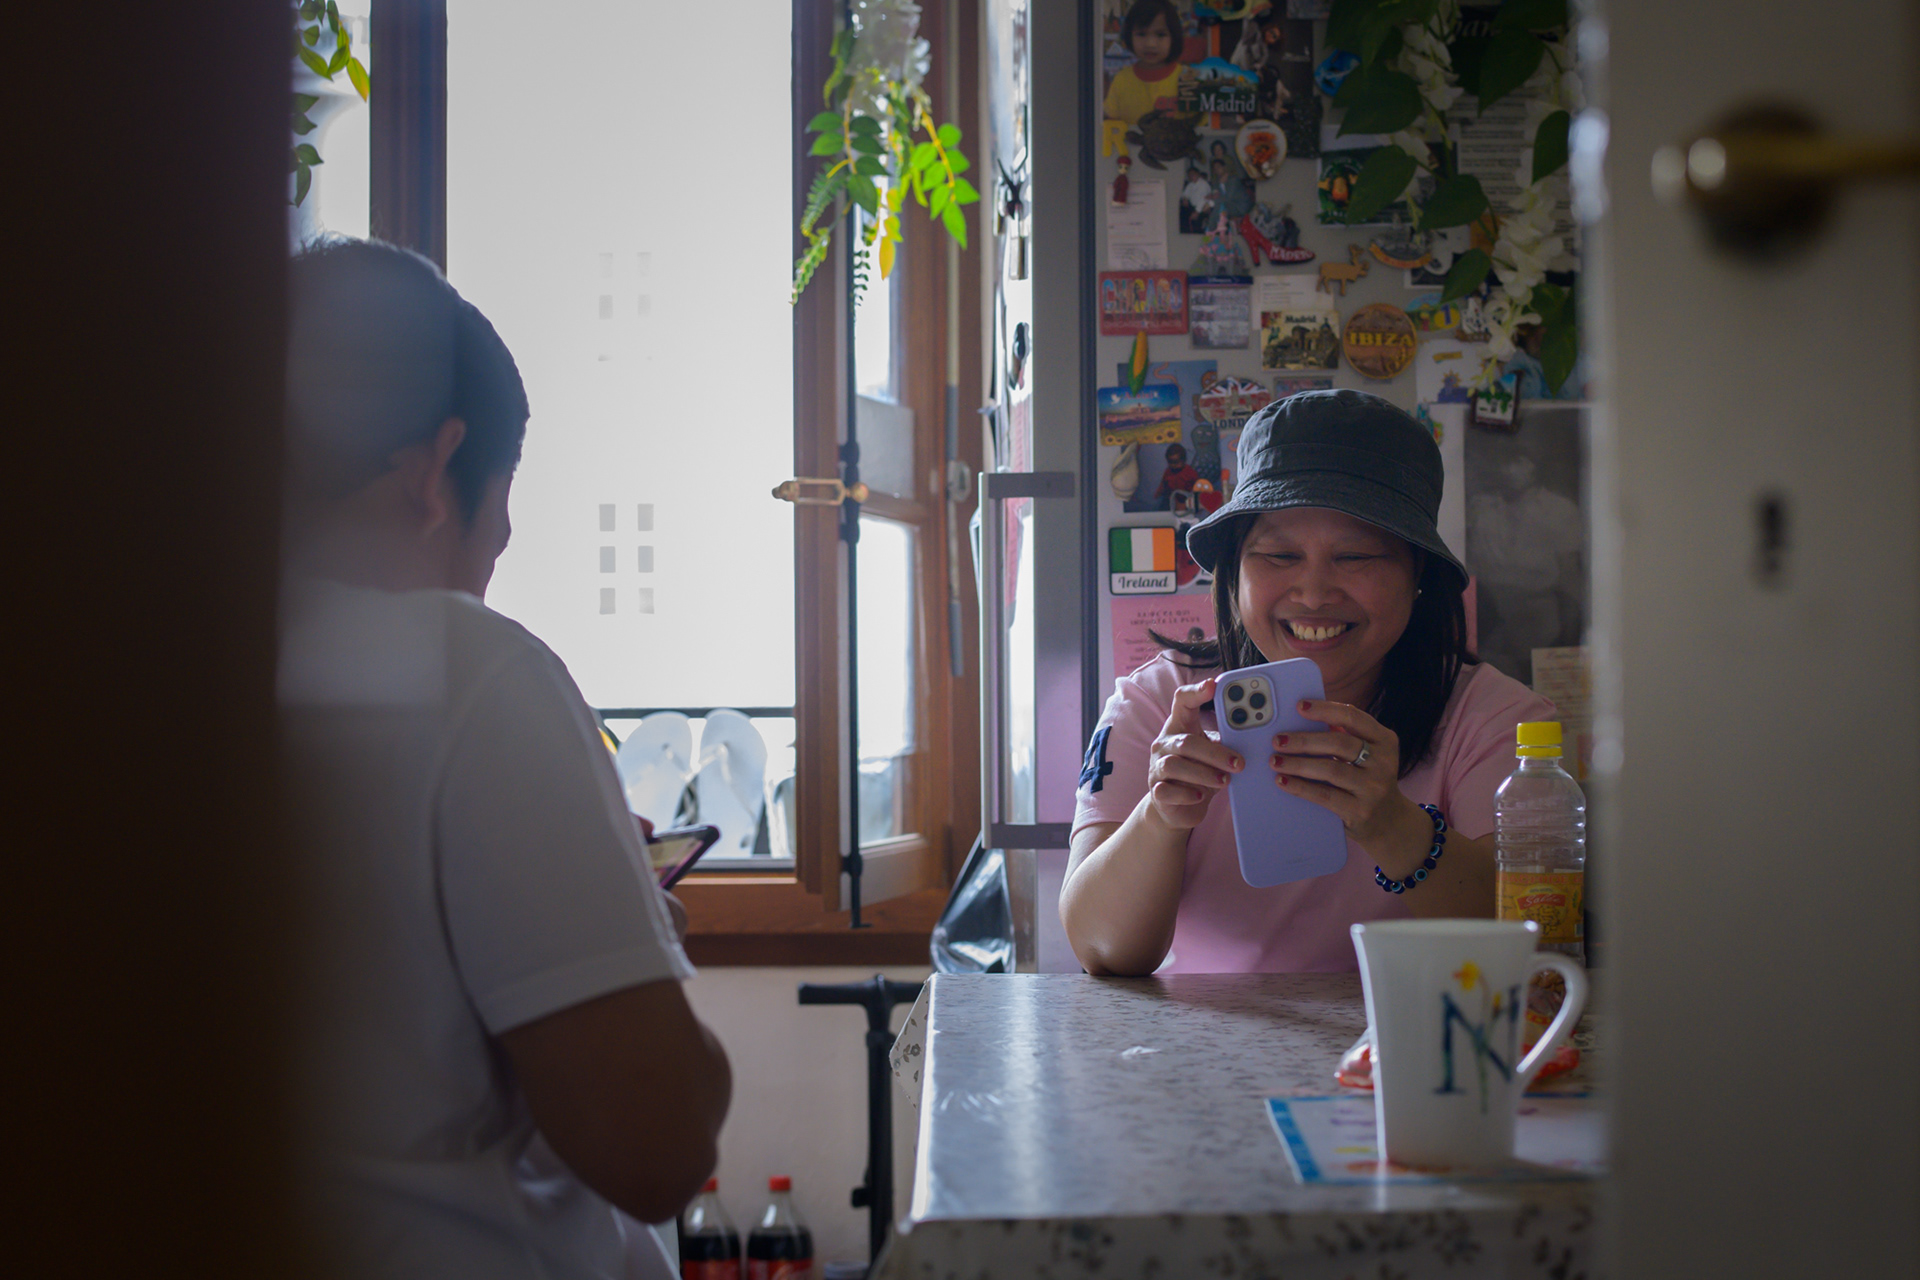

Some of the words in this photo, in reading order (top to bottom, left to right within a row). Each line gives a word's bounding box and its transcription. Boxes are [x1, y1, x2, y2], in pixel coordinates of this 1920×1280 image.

[1200, 93, 1255, 112] Madrid
[1103, 120, 1128, 157] R
[1103, 278, 1182, 313] CHICAGO
[1285, 315, 1316, 323] Madrid
[1350, 332, 1414, 347] IBIZA
[1213, 417, 1251, 429] LOND
[1118, 575, 1168, 589] Ireland
[1433, 984, 1521, 1095] N
